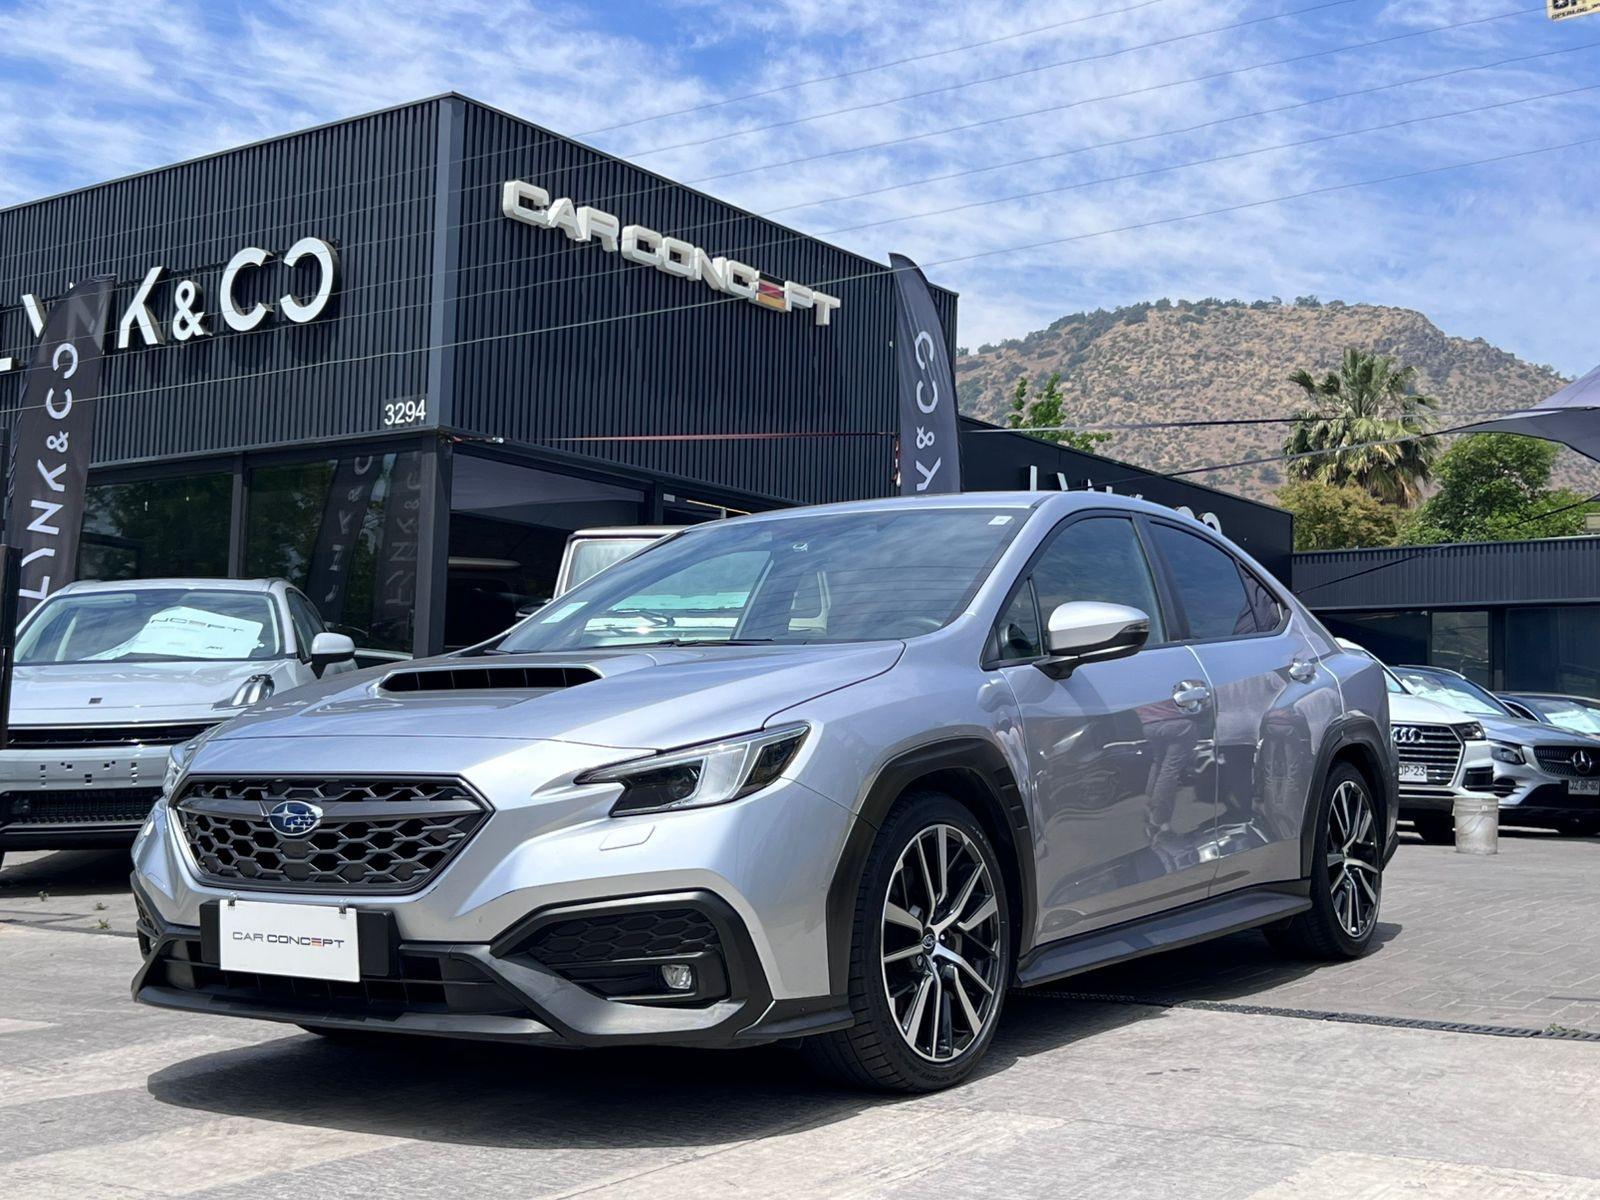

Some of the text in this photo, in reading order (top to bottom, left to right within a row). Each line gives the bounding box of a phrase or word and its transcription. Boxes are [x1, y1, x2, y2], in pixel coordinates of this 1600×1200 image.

[503, 180, 841, 326] CAR CONCEPT
[384, 399, 426, 425] 3294
[233, 931, 344, 948] CAR CONCEPT
